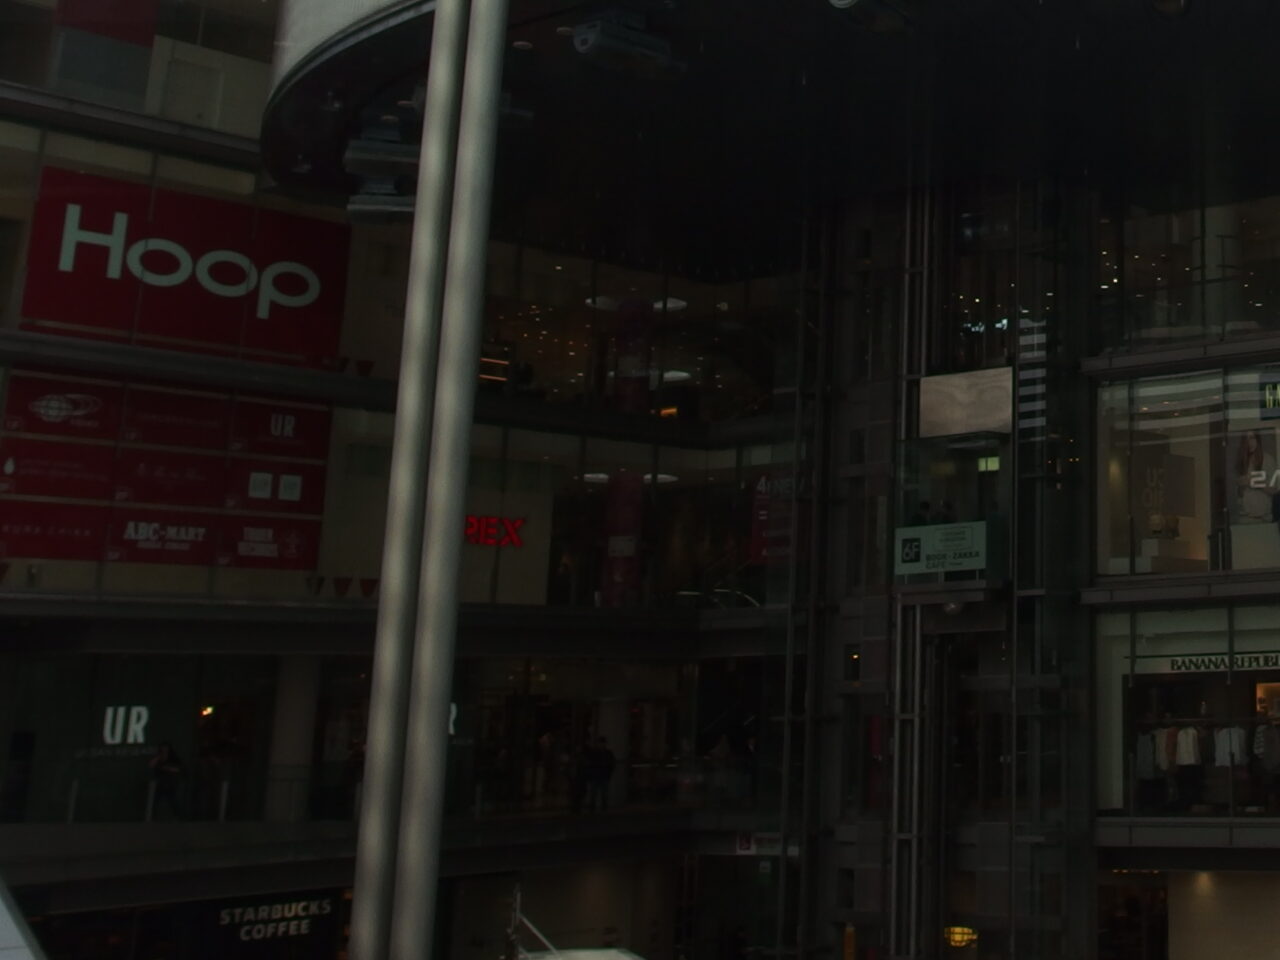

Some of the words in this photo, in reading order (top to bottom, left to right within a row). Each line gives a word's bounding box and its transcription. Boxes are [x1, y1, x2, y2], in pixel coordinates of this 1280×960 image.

[57, 203, 322, 320] Hoop
[270, 413, 296, 438] UR
[123, 520, 208, 542] ABC-MART
[902, 542, 920, 561] 6F
[1170, 656, 1231, 672] BANANA
[102, 704, 150, 746] UR
[218, 898, 333, 926] STARBUCKS
[239, 919, 313, 942] COFFEE
